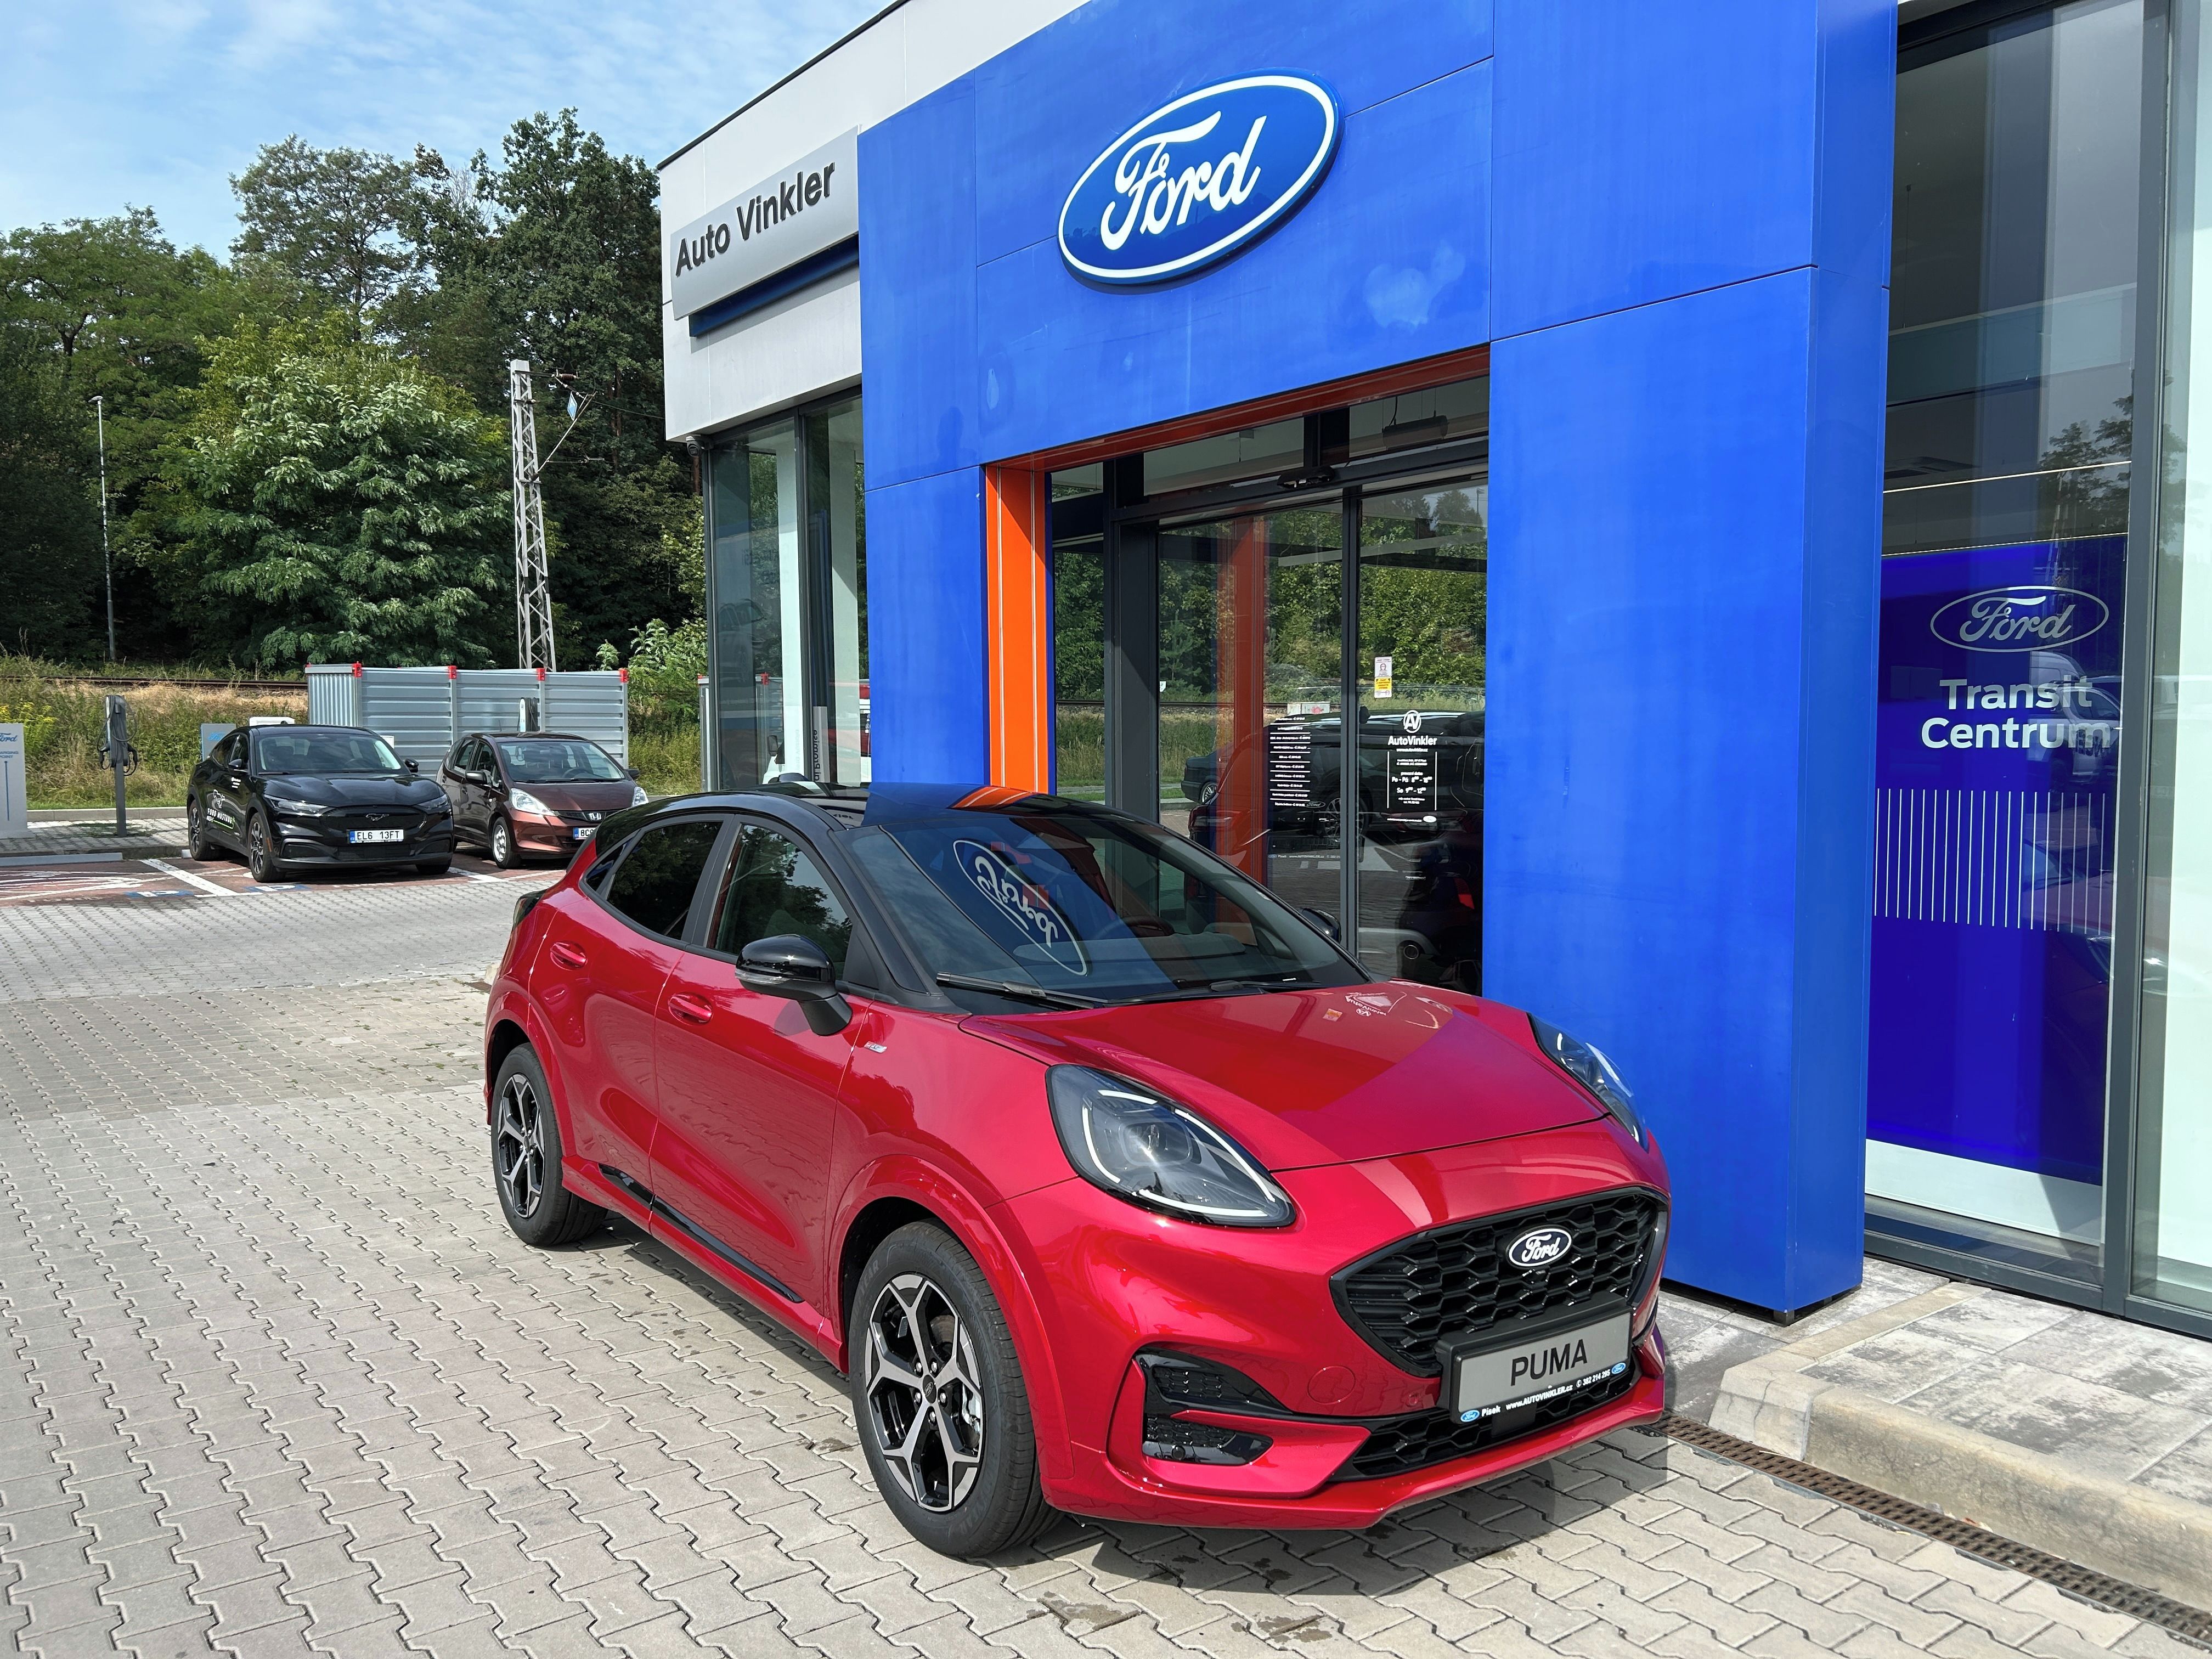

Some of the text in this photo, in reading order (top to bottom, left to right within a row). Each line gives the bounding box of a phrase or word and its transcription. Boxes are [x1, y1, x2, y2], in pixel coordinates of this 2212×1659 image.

[1101, 110, 1267, 250] Ford
[675, 161, 835, 276] Auto Vinkler
[1959, 595, 2076, 641] Ford
[1939, 674, 2093, 710] Transit
[1387, 735, 1437, 745] AutoVinkler
[1921, 717, 2111, 749] Centrum
[357, 832, 373, 840] EL6
[379, 831, 400, 839] 13FT
[1521, 1233, 1561, 1263] Ford
[1510, 1339, 1588, 1386] PUMA
